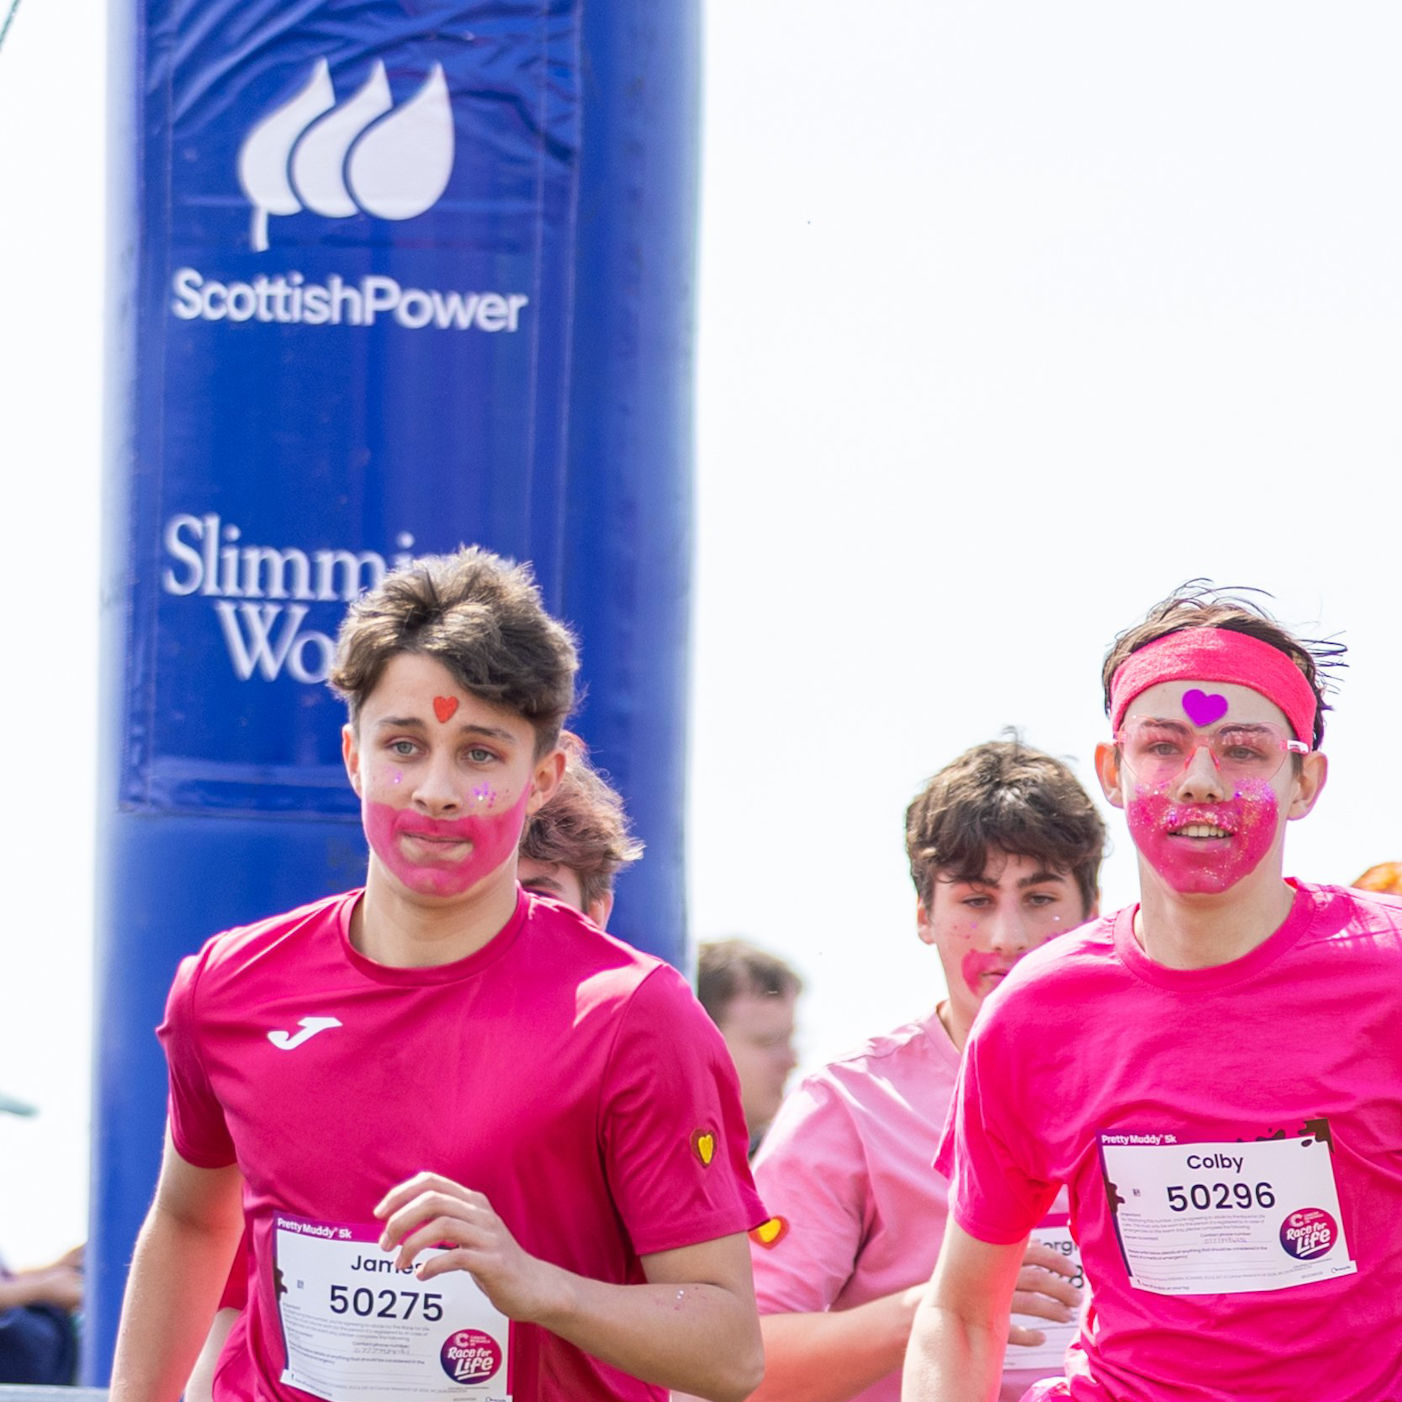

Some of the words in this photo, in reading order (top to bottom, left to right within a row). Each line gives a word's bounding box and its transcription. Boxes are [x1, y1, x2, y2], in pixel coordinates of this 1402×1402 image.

[172, 266, 529, 333] ScottishPower
[1101, 1134, 1129, 1145] Pretty
[1186, 1153, 1244, 1174] Colby
[1166, 1181, 1276, 1213] 50296
[277, 1216, 303, 1234] Pretty
[1286, 1225, 1311, 1241] Race
[1296, 1228, 1331, 1254] Life
[330, 1285, 444, 1322] 50275
[447, 1346, 476, 1360] Race
[454, 1357, 494, 1377] Life
